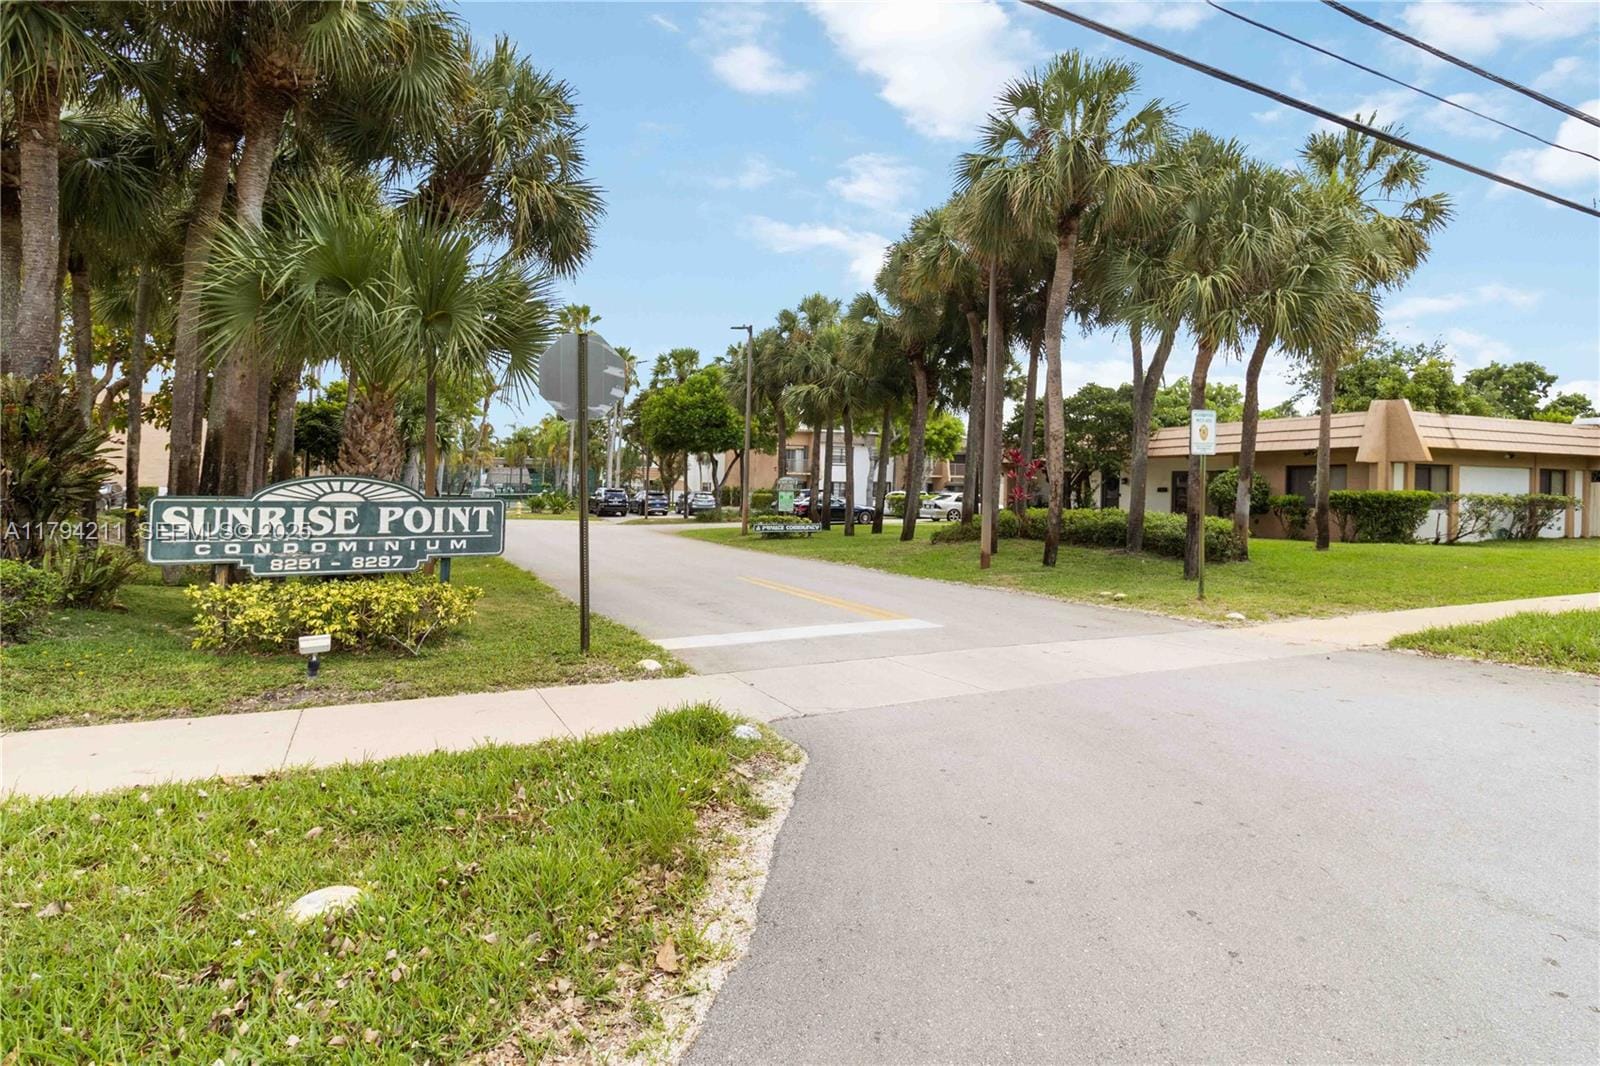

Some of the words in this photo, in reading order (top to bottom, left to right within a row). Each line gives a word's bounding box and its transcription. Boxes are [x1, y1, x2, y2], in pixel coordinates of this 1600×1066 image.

[161, 506, 360, 536] SUNRISE
[377, 506, 495, 534] POINT
[194, 539, 467, 555] CONDOMINIUM
[270, 558, 321, 571] 8251
[352, 556, 403, 568] 8287
